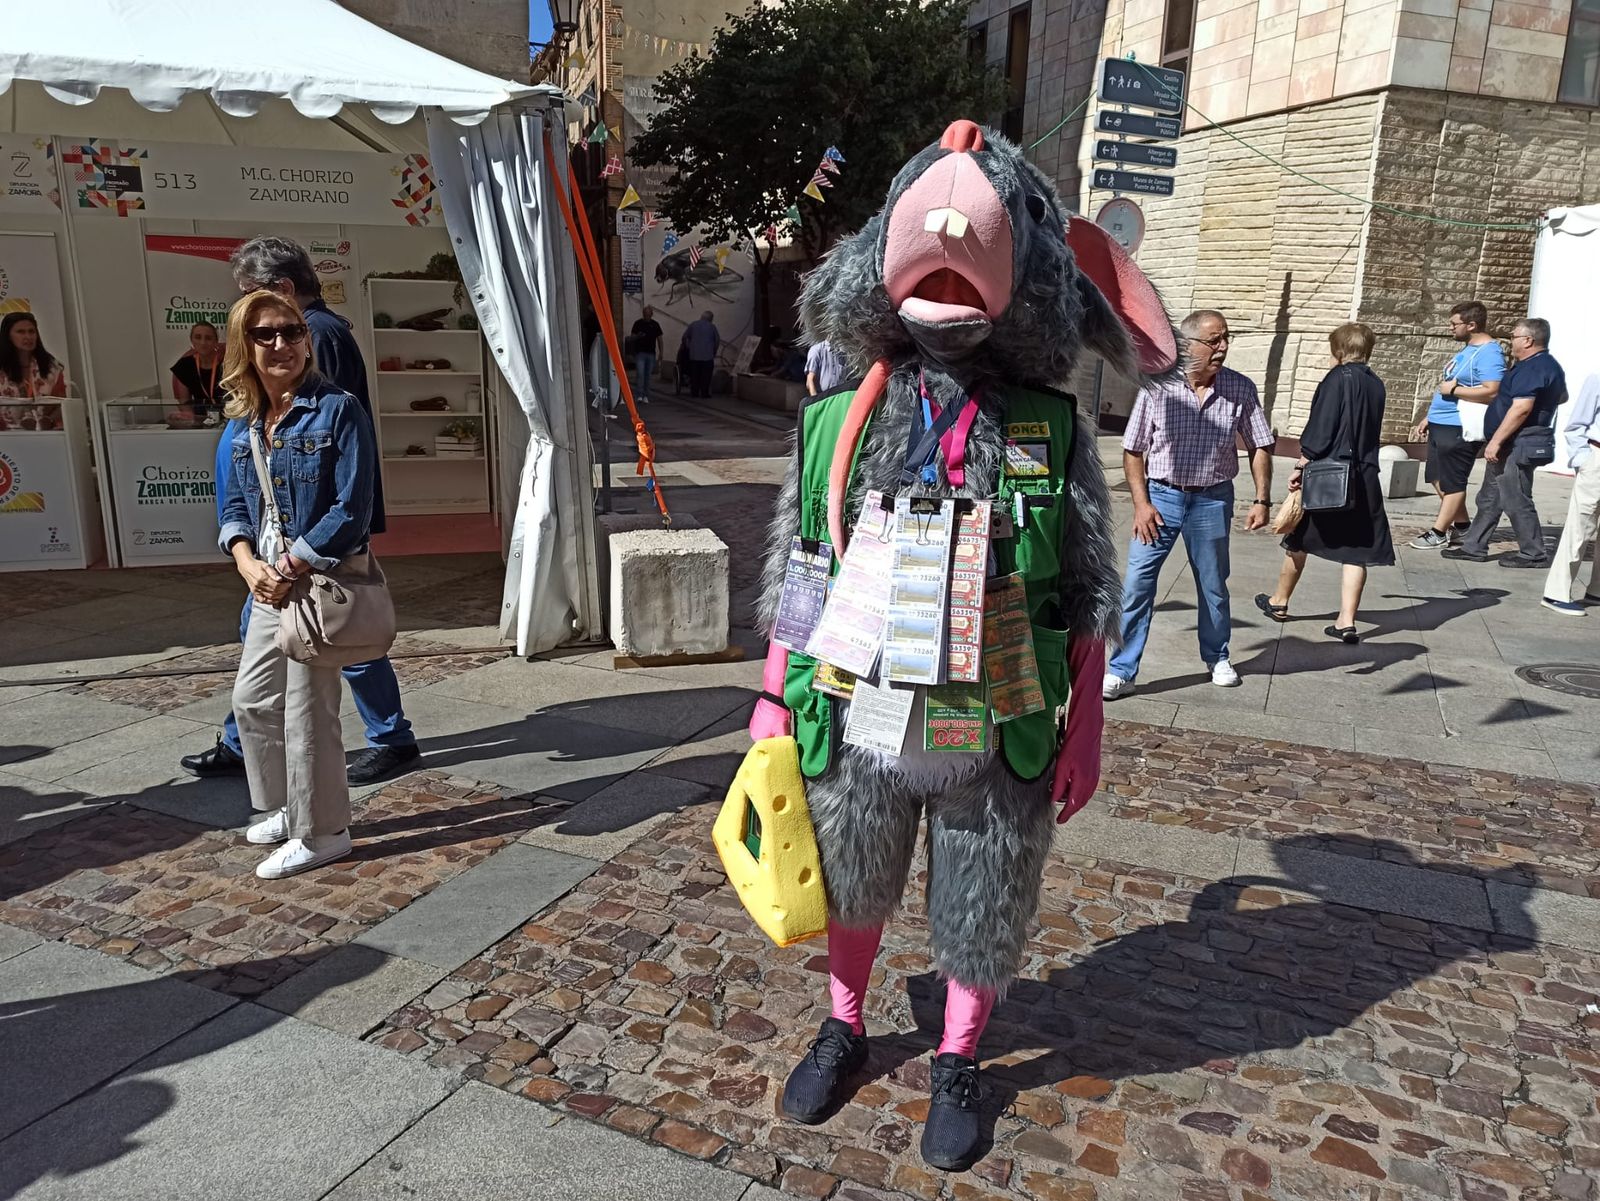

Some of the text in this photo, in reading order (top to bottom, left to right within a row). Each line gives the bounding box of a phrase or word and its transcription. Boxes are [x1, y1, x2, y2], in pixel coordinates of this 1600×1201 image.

[154, 172, 197, 190] 513
[241, 166, 354, 185] M.G. CHORIZO
[8, 188, 41, 197] ZAMORA
[249, 187, 350, 204] ZAMORANO
[170, 295, 227, 310] Chorizo
[1011, 425, 1045, 434] ONCE
[142, 465, 210, 481] Chorizo
[136, 480, 216, 498] Zamorano
[149, 537, 184, 545] ZAMORA
